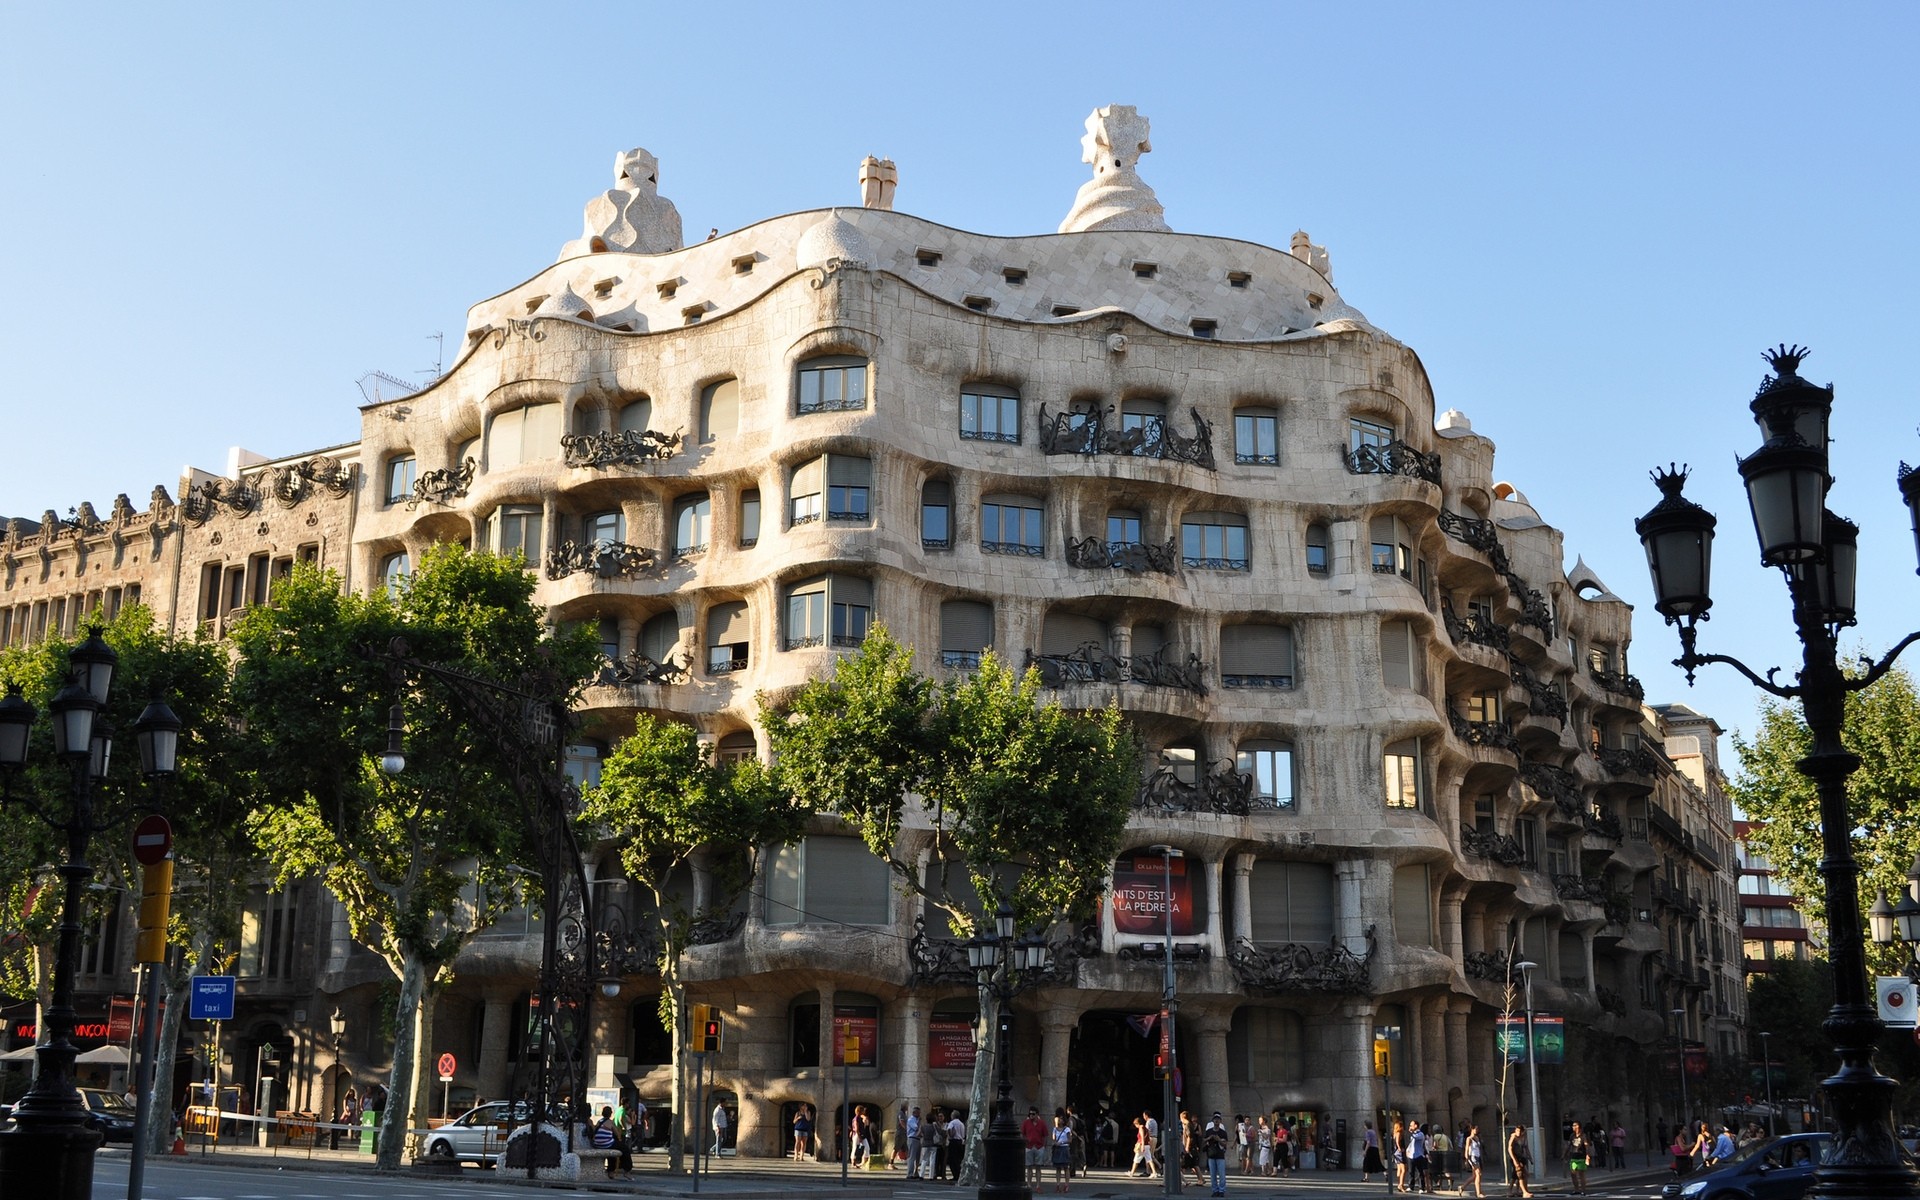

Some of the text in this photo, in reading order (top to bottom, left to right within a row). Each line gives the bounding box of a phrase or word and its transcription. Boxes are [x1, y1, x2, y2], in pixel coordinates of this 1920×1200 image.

[1138, 891, 1176, 901] D'ESTU
[1120, 902, 1132, 910] LA
[1134, 902, 1180, 912] PEDREA
[204, 1004, 220, 1012] taxi
[17, 1025, 36, 1038] VINÇ
[74, 1024, 109, 1038] VINÇON
